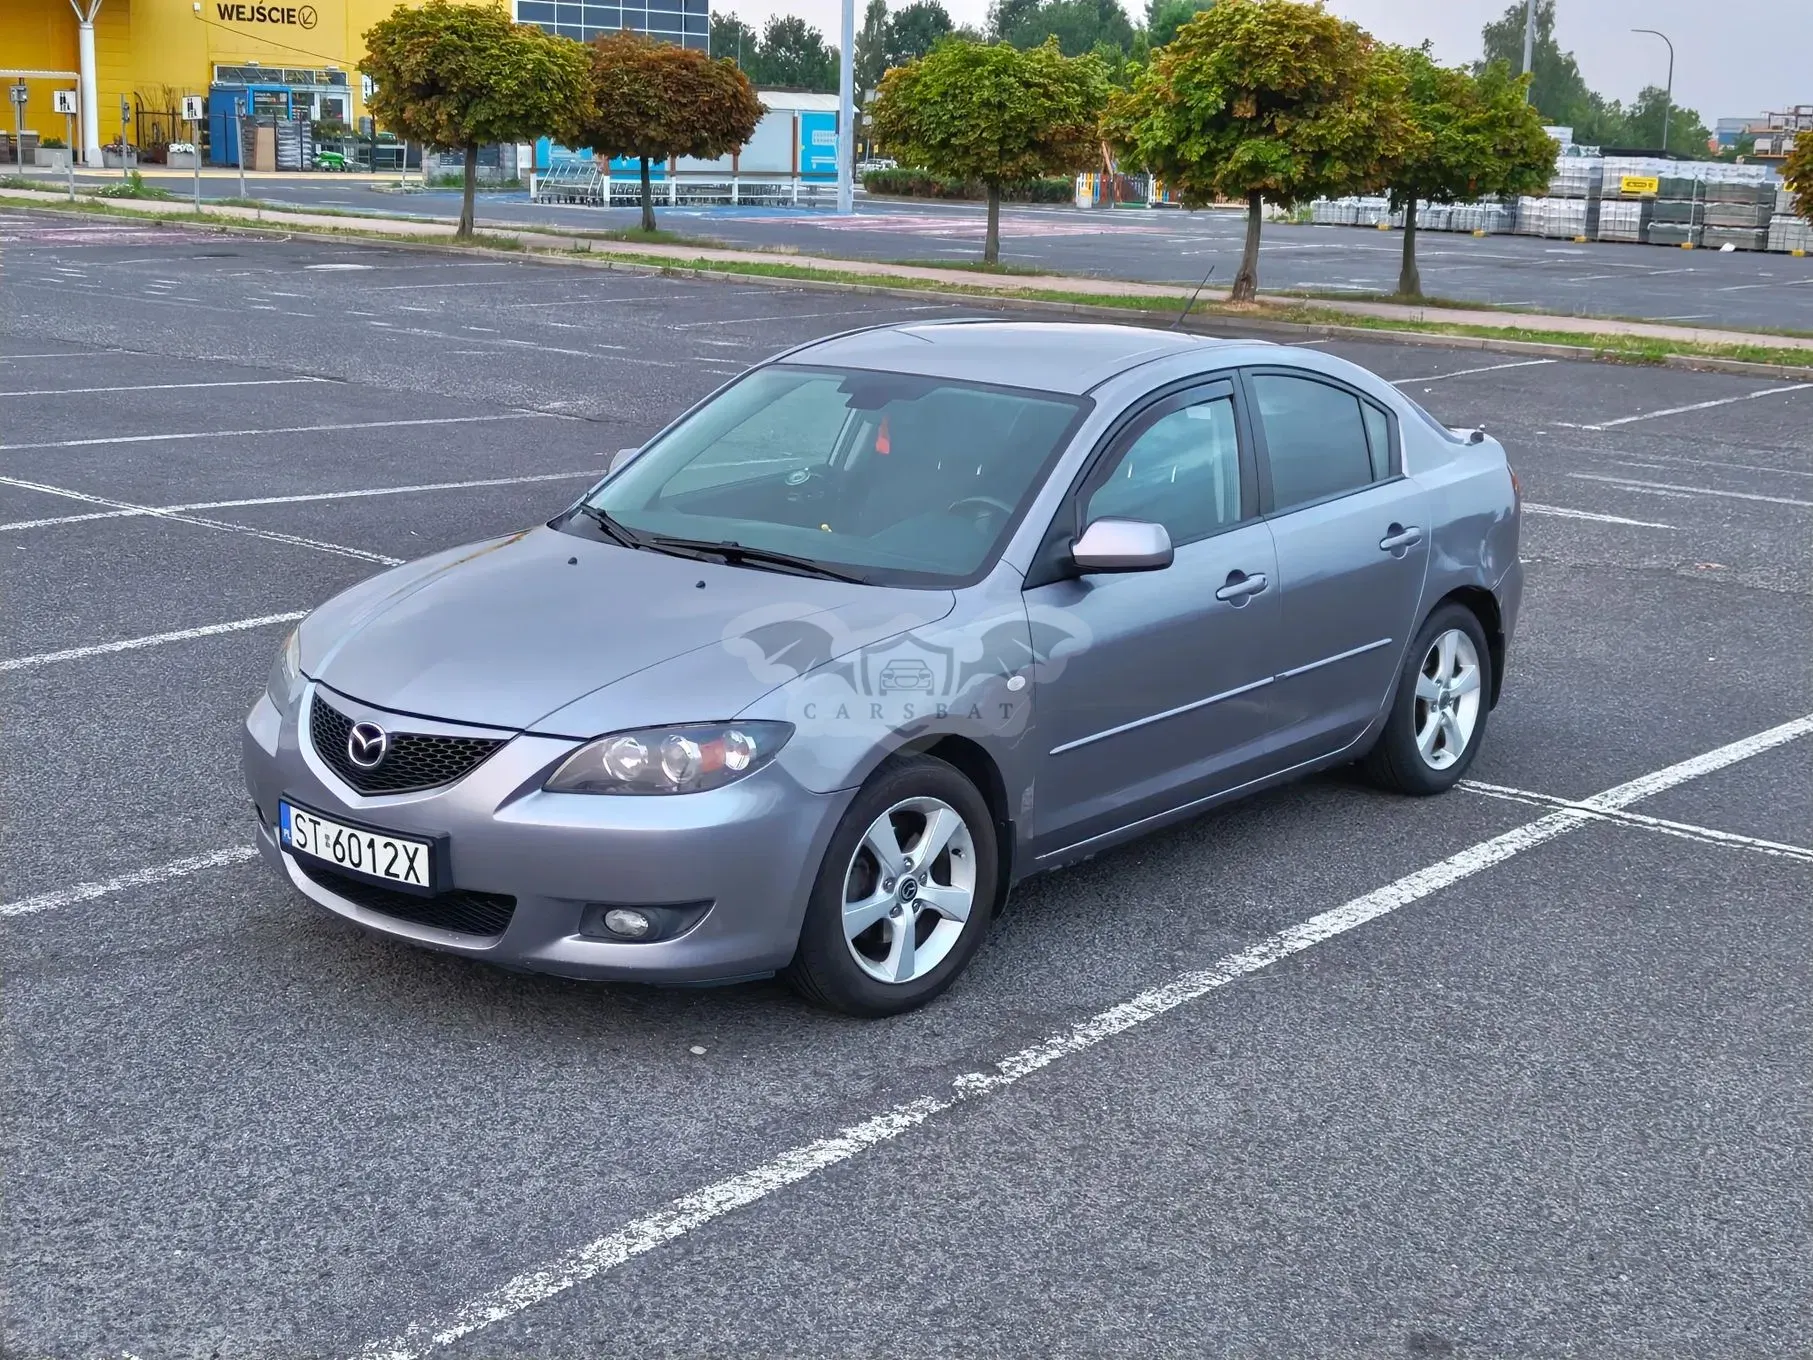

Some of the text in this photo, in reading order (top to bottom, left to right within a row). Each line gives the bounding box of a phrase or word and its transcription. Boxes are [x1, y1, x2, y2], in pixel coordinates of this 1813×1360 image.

[217, 0, 297, 24] WEJŚCIE
[295, 813, 421, 884] ST 6012X
